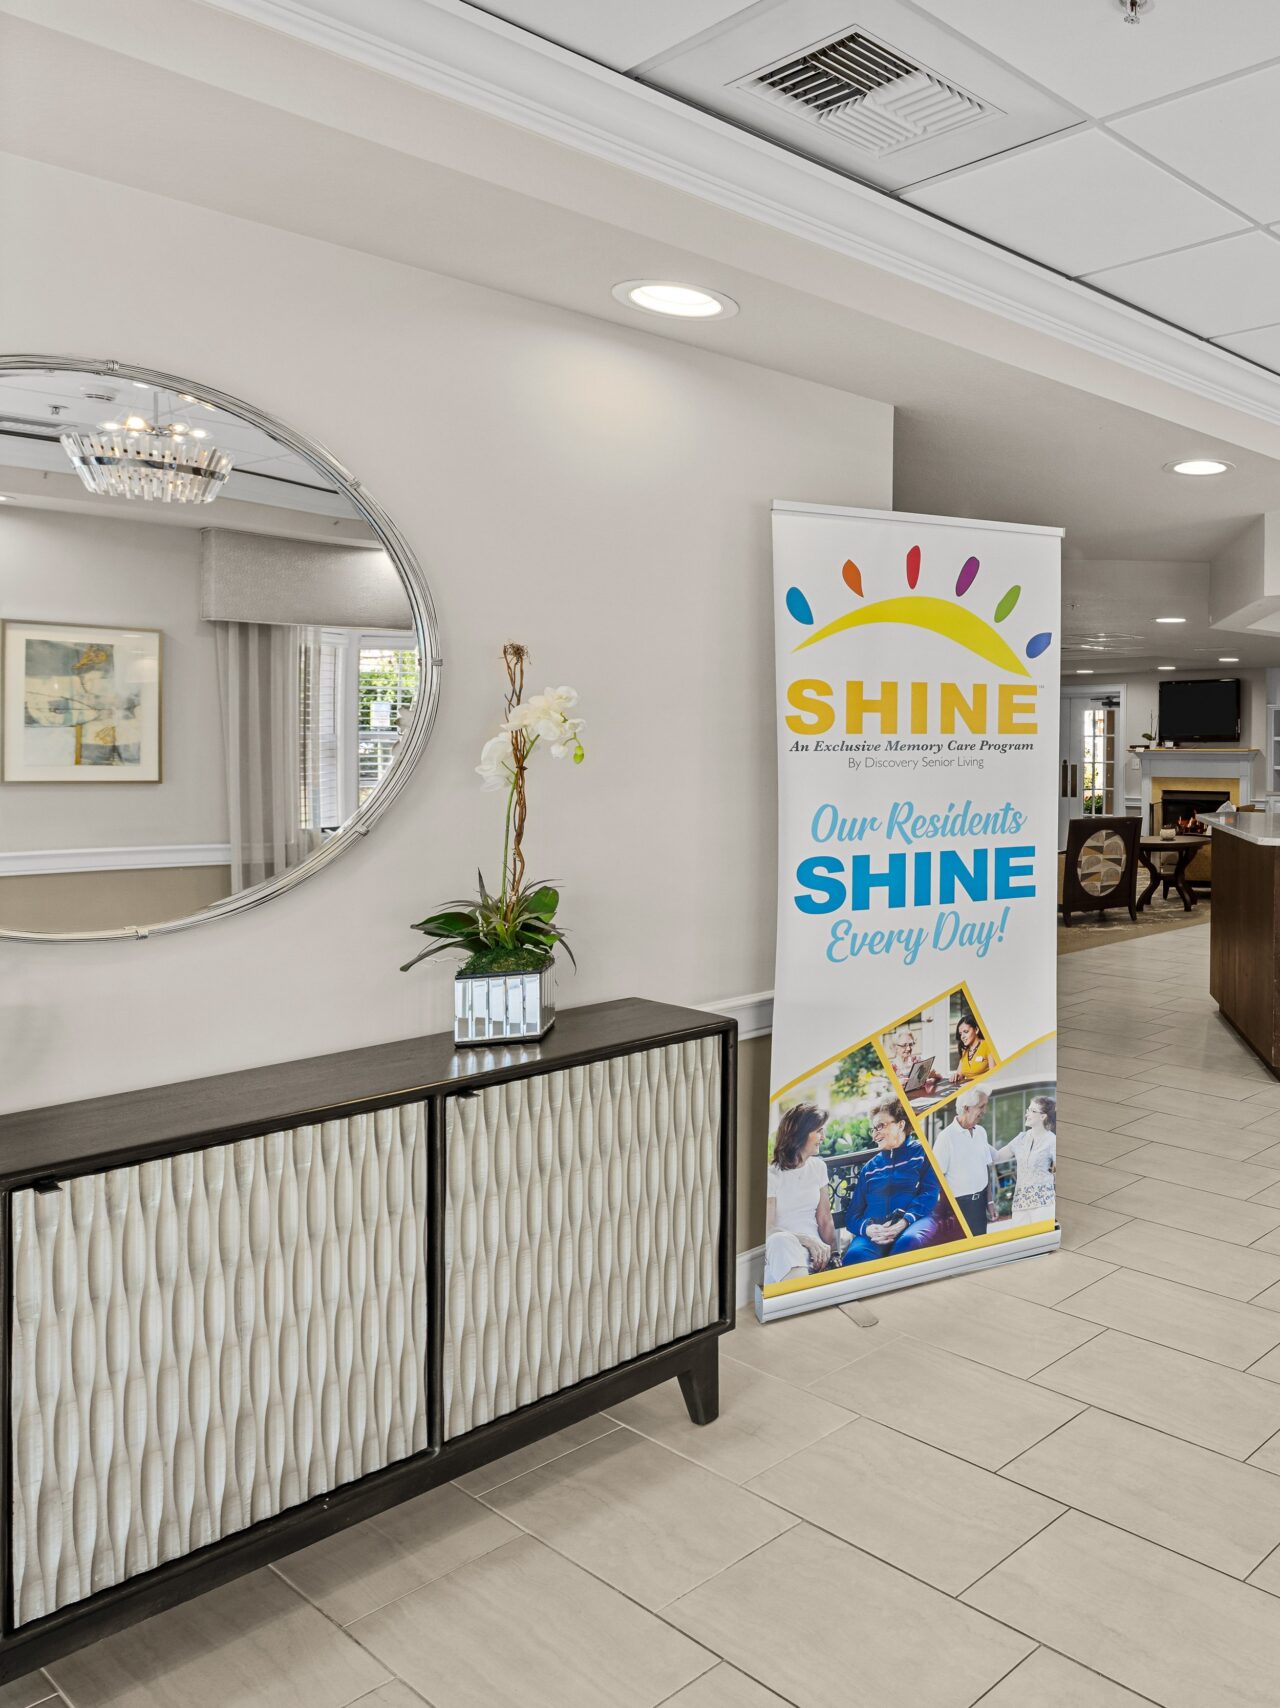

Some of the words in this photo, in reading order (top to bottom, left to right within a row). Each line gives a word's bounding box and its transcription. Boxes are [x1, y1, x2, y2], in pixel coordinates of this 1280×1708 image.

[789, 740, 810, 752] An
[813, 740, 881, 752] Exclusive
[885, 740, 943, 755] Memory
[947, 739, 976, 751] Care
[979, 740, 1034, 754] Program
[848, 757, 861, 770] By
[864, 757, 918, 770] Discovery
[921, 756, 955, 768] Senior
[957, 756, 984, 770] Living
[811, 804, 882, 843] Our
[886, 800, 1027, 845] Residents
[794, 846, 1036, 915] SHINE
[826, 916, 928, 966] Every
[932, 906, 1010, 958] Day!
